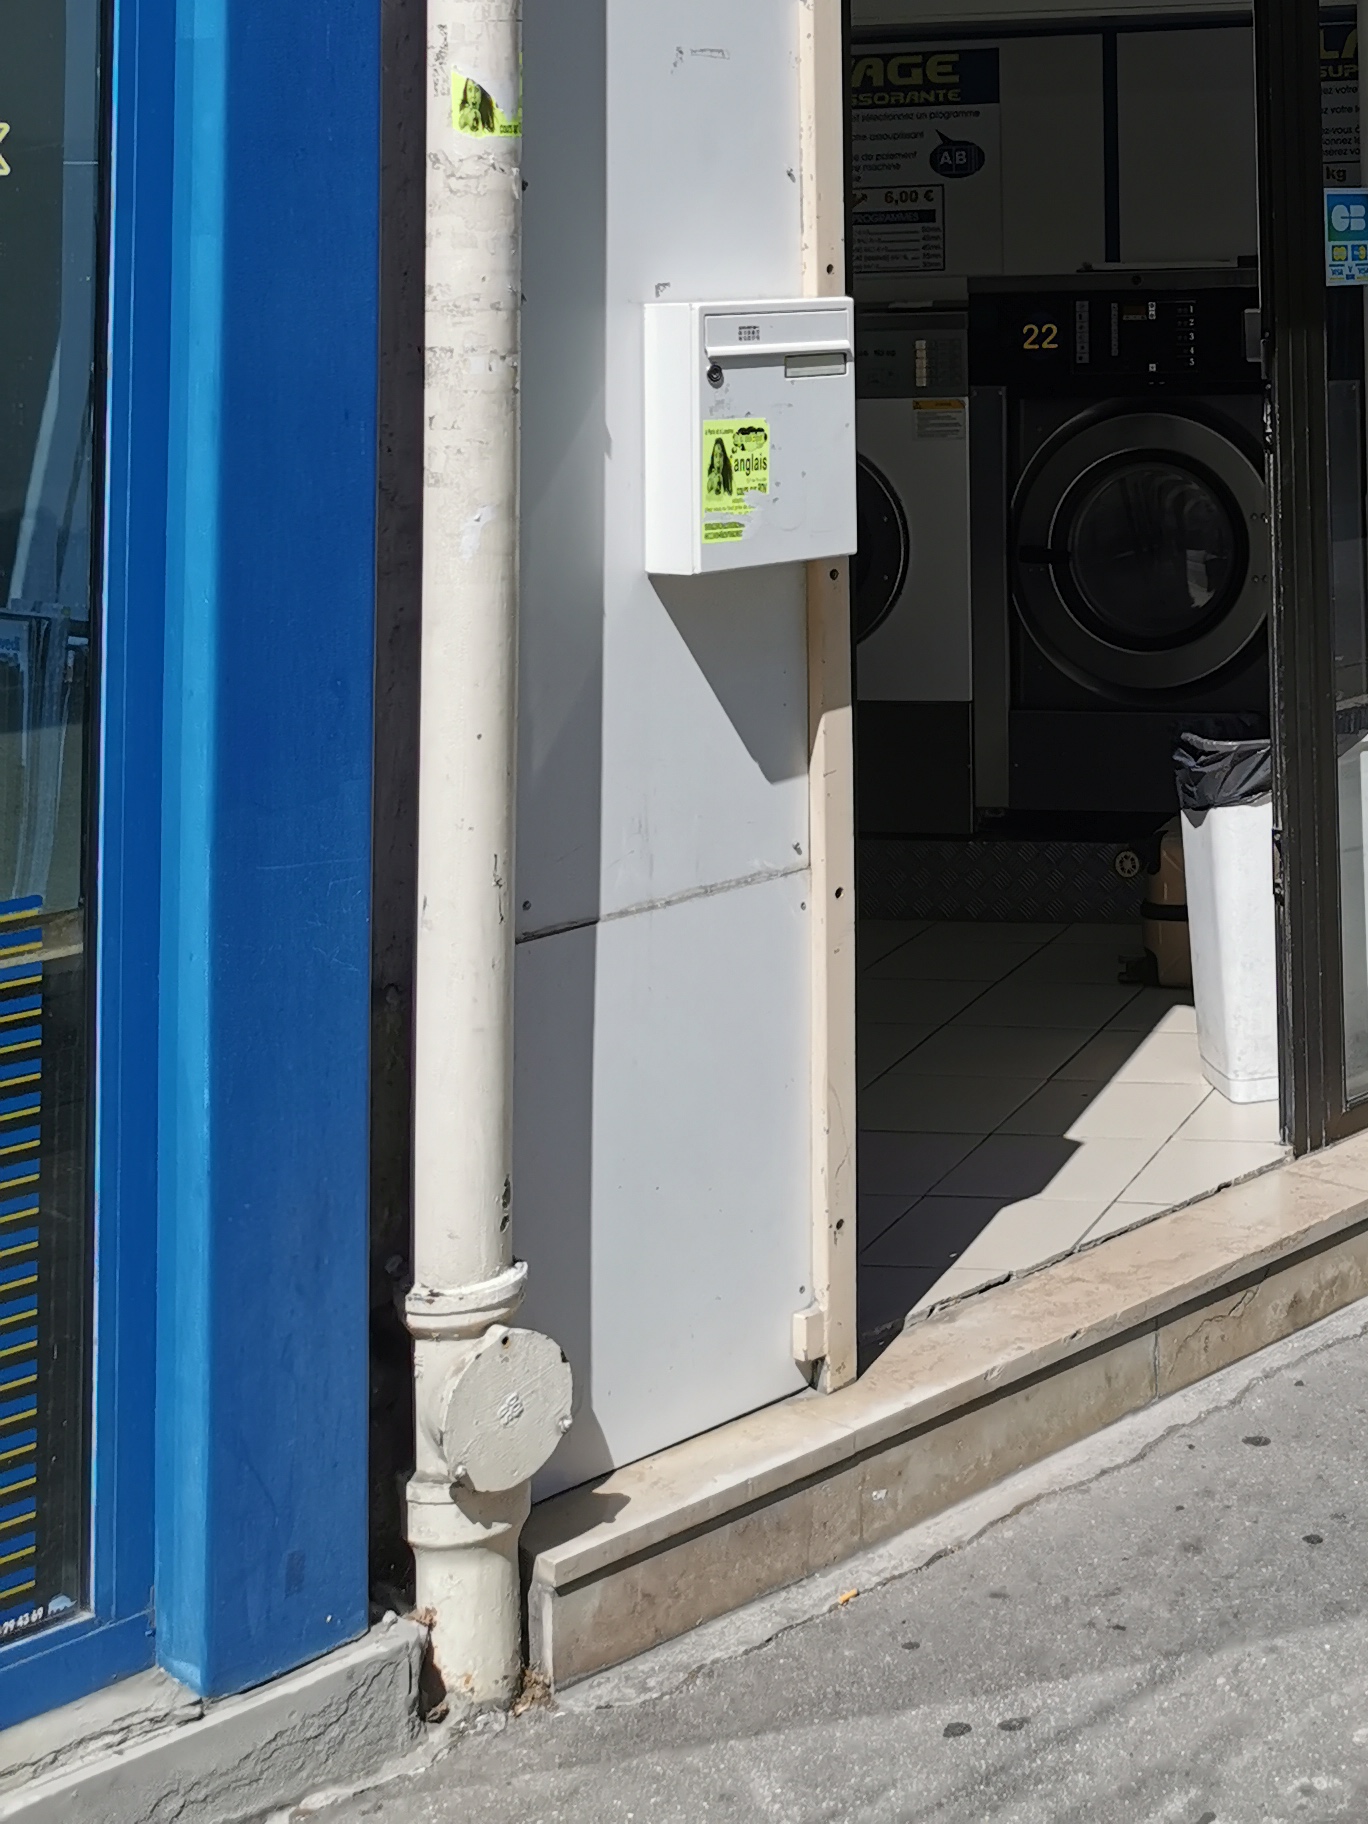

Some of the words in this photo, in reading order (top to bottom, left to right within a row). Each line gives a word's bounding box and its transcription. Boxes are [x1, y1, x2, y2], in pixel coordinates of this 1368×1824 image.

[852, 53, 960, 88] AGE
[1326, 165, 1347, 182] kg
[884, 190, 919, 205] 6,00
[923, 189, 934, 202] €
[1022, 323, 1059, 350] 22
[733, 452, 768, 476] anglais
[31, 1606, 44, 1623] 69
